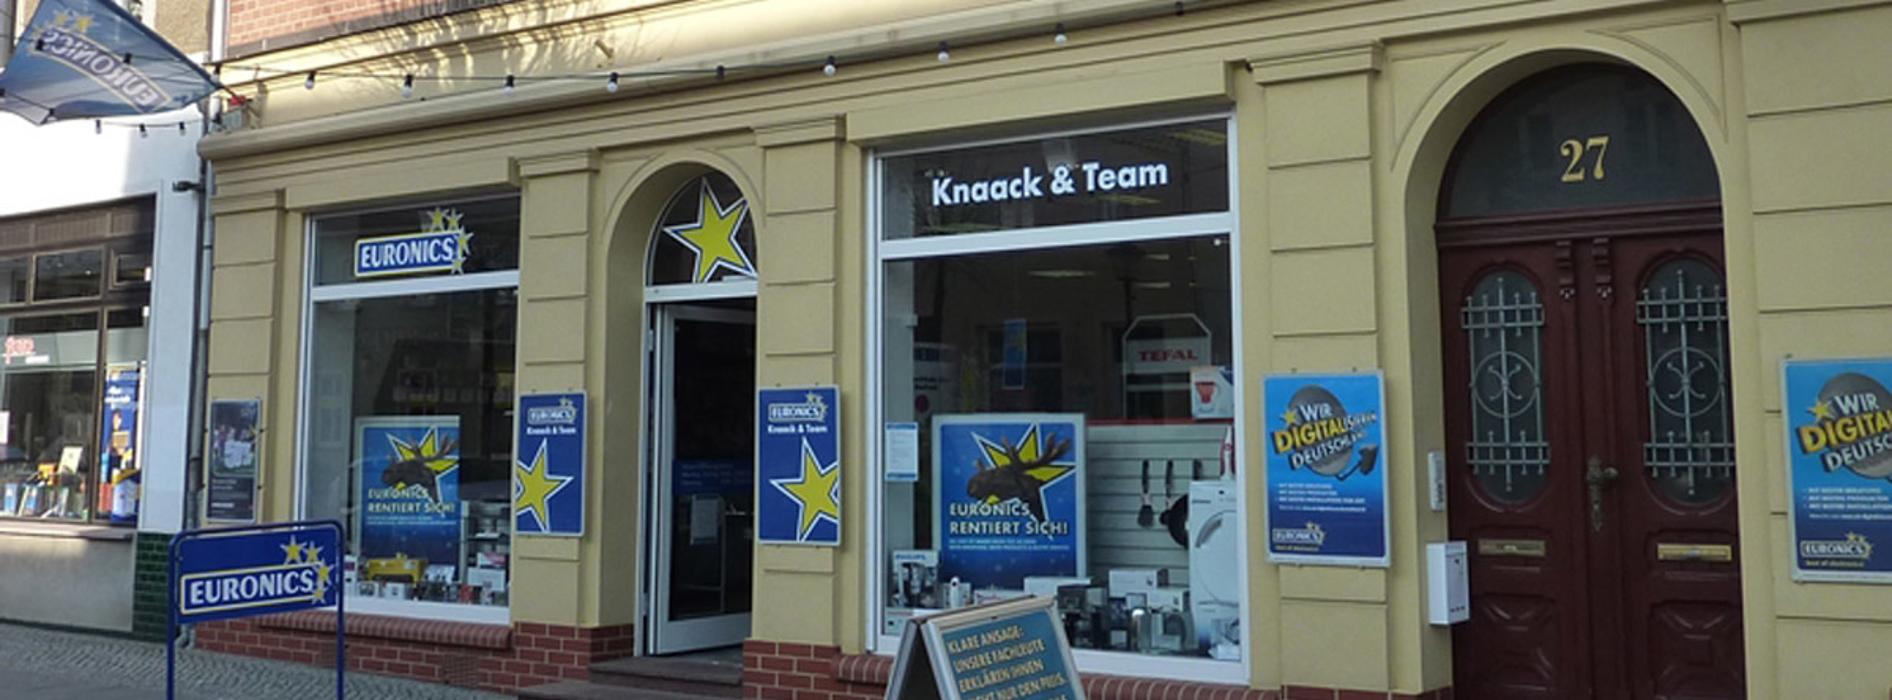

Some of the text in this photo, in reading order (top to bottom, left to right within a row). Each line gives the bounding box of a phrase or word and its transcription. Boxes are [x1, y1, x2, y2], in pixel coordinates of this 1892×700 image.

[1560, 136, 1609, 182] 27
[932, 161, 1168, 206] Knaack & Team
[360, 236, 455, 269] EURONICS
[1138, 350, 1198, 362] TEFAL
[1834, 392, 1879, 416] WIR
[368, 502, 420, 513] RENTIERT
[949, 502, 1031, 517] EURONICS
[949, 521, 1069, 535] RENTIERT SICH!
[189, 568, 314, 606] EURONICS
[947, 634, 980, 654] KLARE
[953, 652, 992, 673] UNSERE
